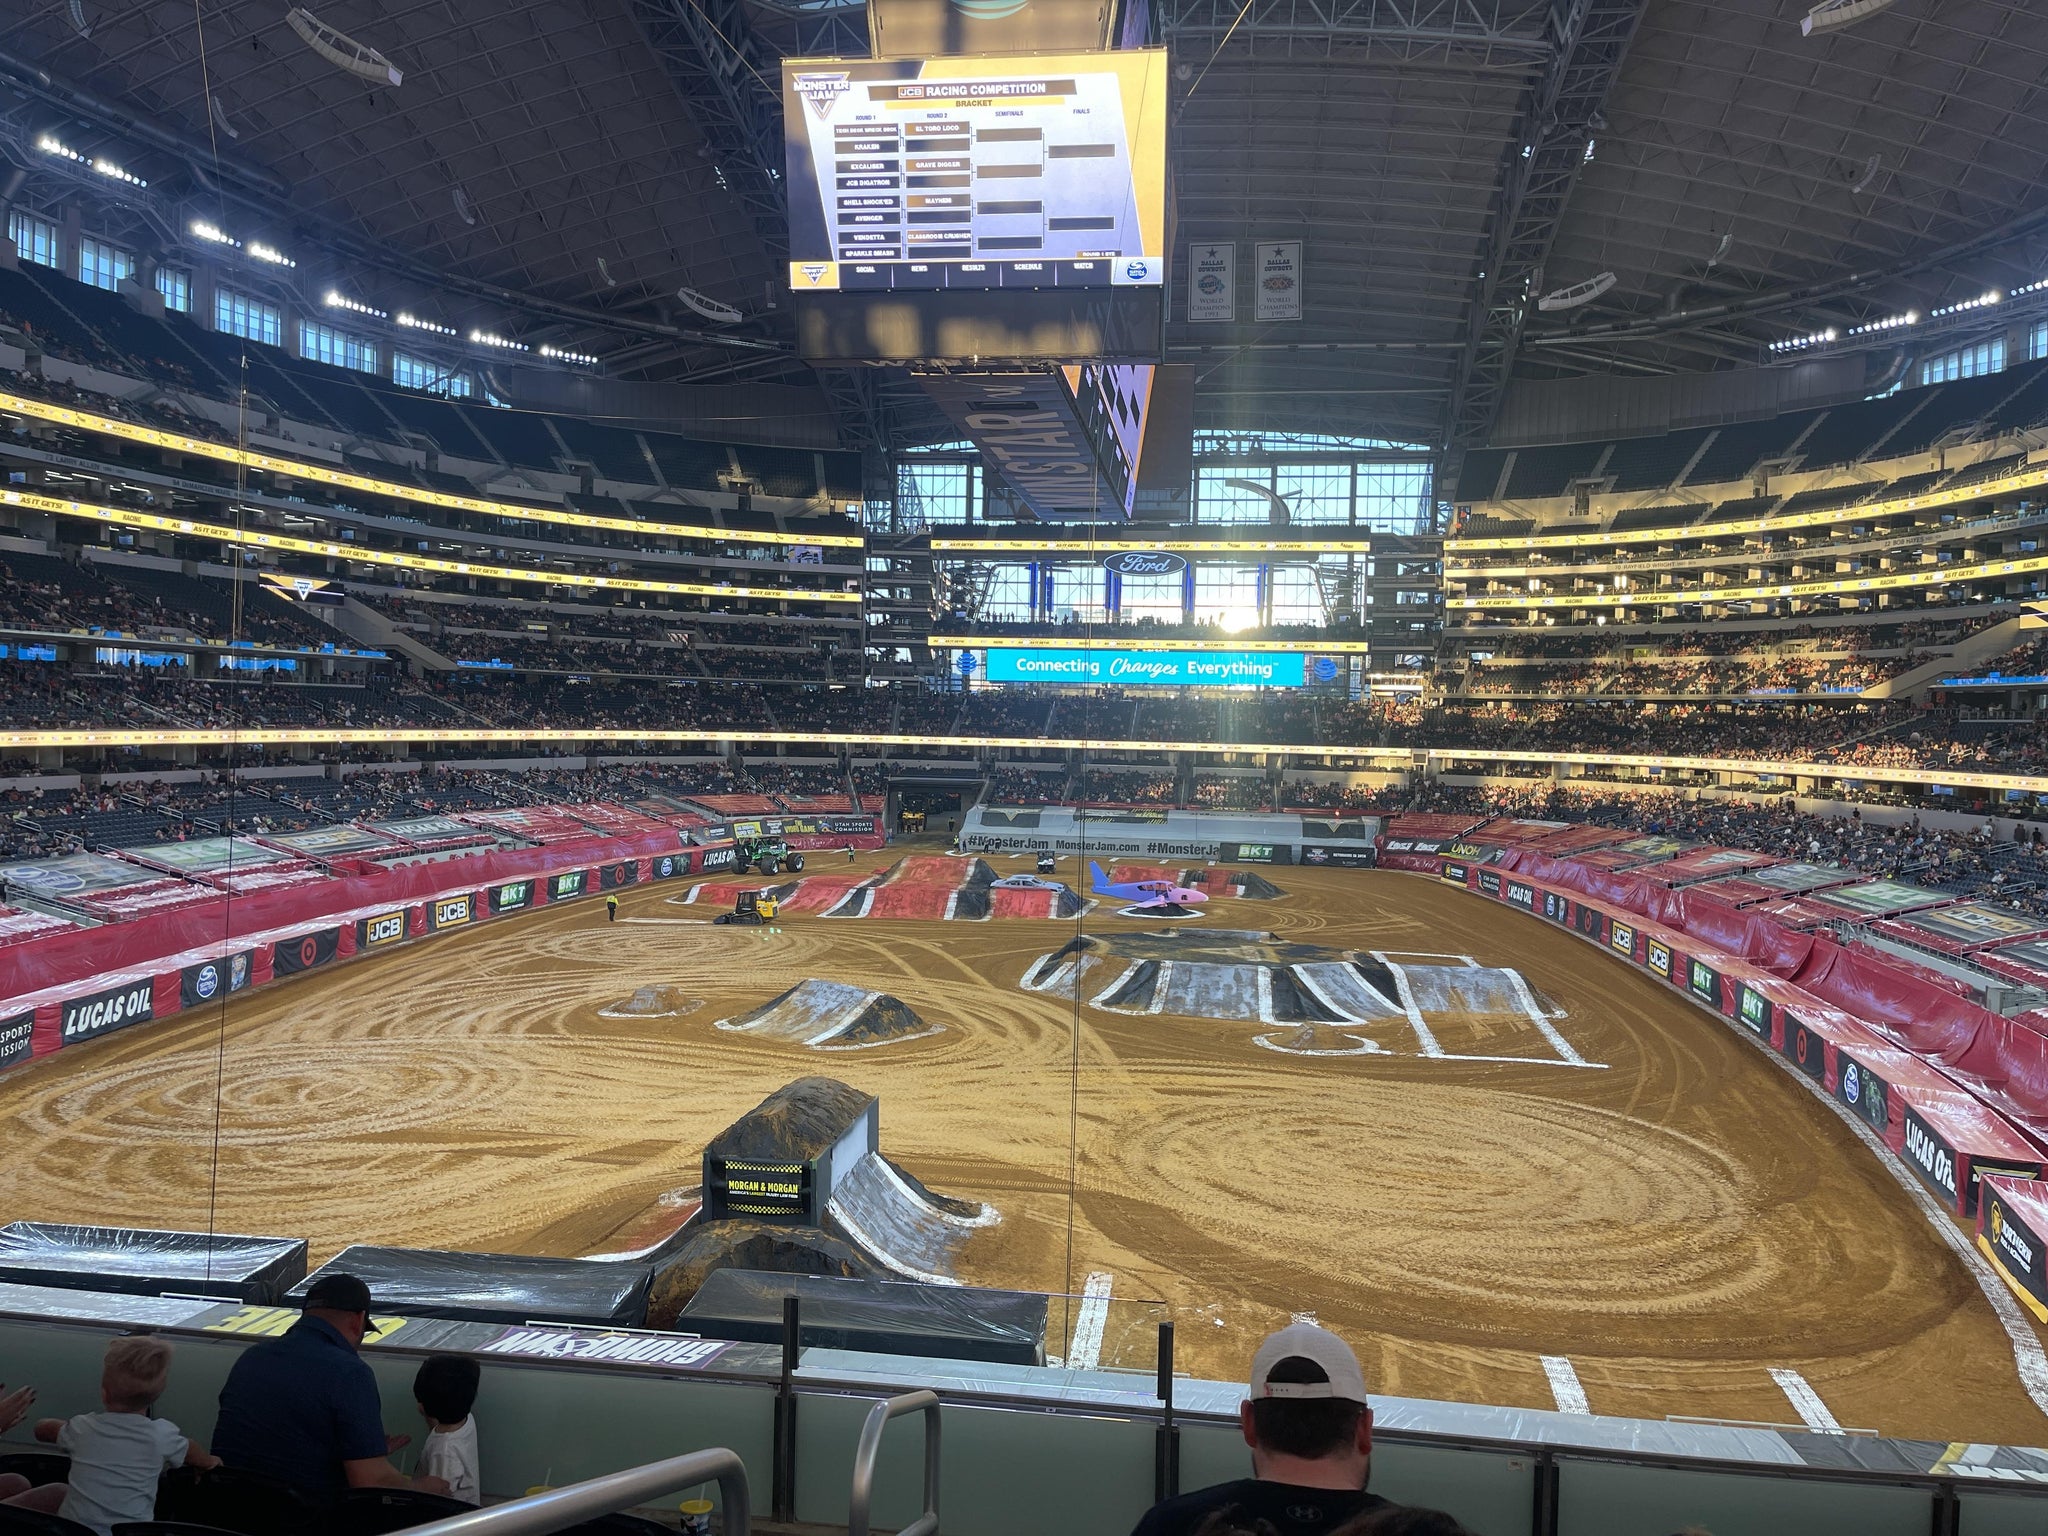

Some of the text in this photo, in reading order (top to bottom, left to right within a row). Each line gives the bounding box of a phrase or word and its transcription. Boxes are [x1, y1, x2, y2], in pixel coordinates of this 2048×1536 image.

[794, 81, 850, 91] MONSTER
[900, 82, 1046, 97] JCB RACING COMPETITION
[810, 90, 835, 100] JAM
[955, 99, 993, 108] BRACKET
[19, 496, 63, 510] AS IT GETS!
[122, 513, 142, 524] RACING
[210, 528, 229, 537] GETS!
[278, 539, 296, 548] RACING
[1893, 538, 1905, 546] BOB
[1905, 536, 1924, 545] HAYES
[352, 550, 369, 558] GETS!
[1782, 551, 1804, 559] HARRIS
[411, 559, 426, 567] RACING
[1119, 553, 1172, 573] Ford
[1623, 562, 1650, 570] RAYFIELD
[1650, 560, 1676, 568] WRIGHT
[2022, 560, 2040, 569] RACING
[1958, 569, 1976, 577] GETS!
[1880, 578, 1897, 586] RACING
[1016, 657, 1273, 679] Connecting Changes Everything
[1055, 839, 1140, 852] MonsterJam.com
[1146, 842, 1219, 856] #MonsterJa
[1239, 844, 1273, 858] BKT
[1451, 843, 1481, 856] UNOH
[703, 850, 727, 866] LUCAS
[557, 875, 581, 891] BKT
[500, 885, 526, 903] BKT
[1507, 885, 1533, 905] LUCAS OIL
[439, 901, 467, 922] JCB
[370, 917, 401, 941] JCB
[1614, 927, 1630, 948] JCB
[1650, 945, 1668, 970] JCB
[1693, 964, 1712, 989] BKT
[65, 987, 152, 1036] LUCAS OIL
[1742, 990, 1763, 1019] BKT
[0, 1022, 33, 1042] SPORTS
[1906, 1118, 1956, 1193] LUCAS OIL
[728, 1180, 798, 1194] MORGAN & MORGAN
[203, 1306, 408, 1344] GME
